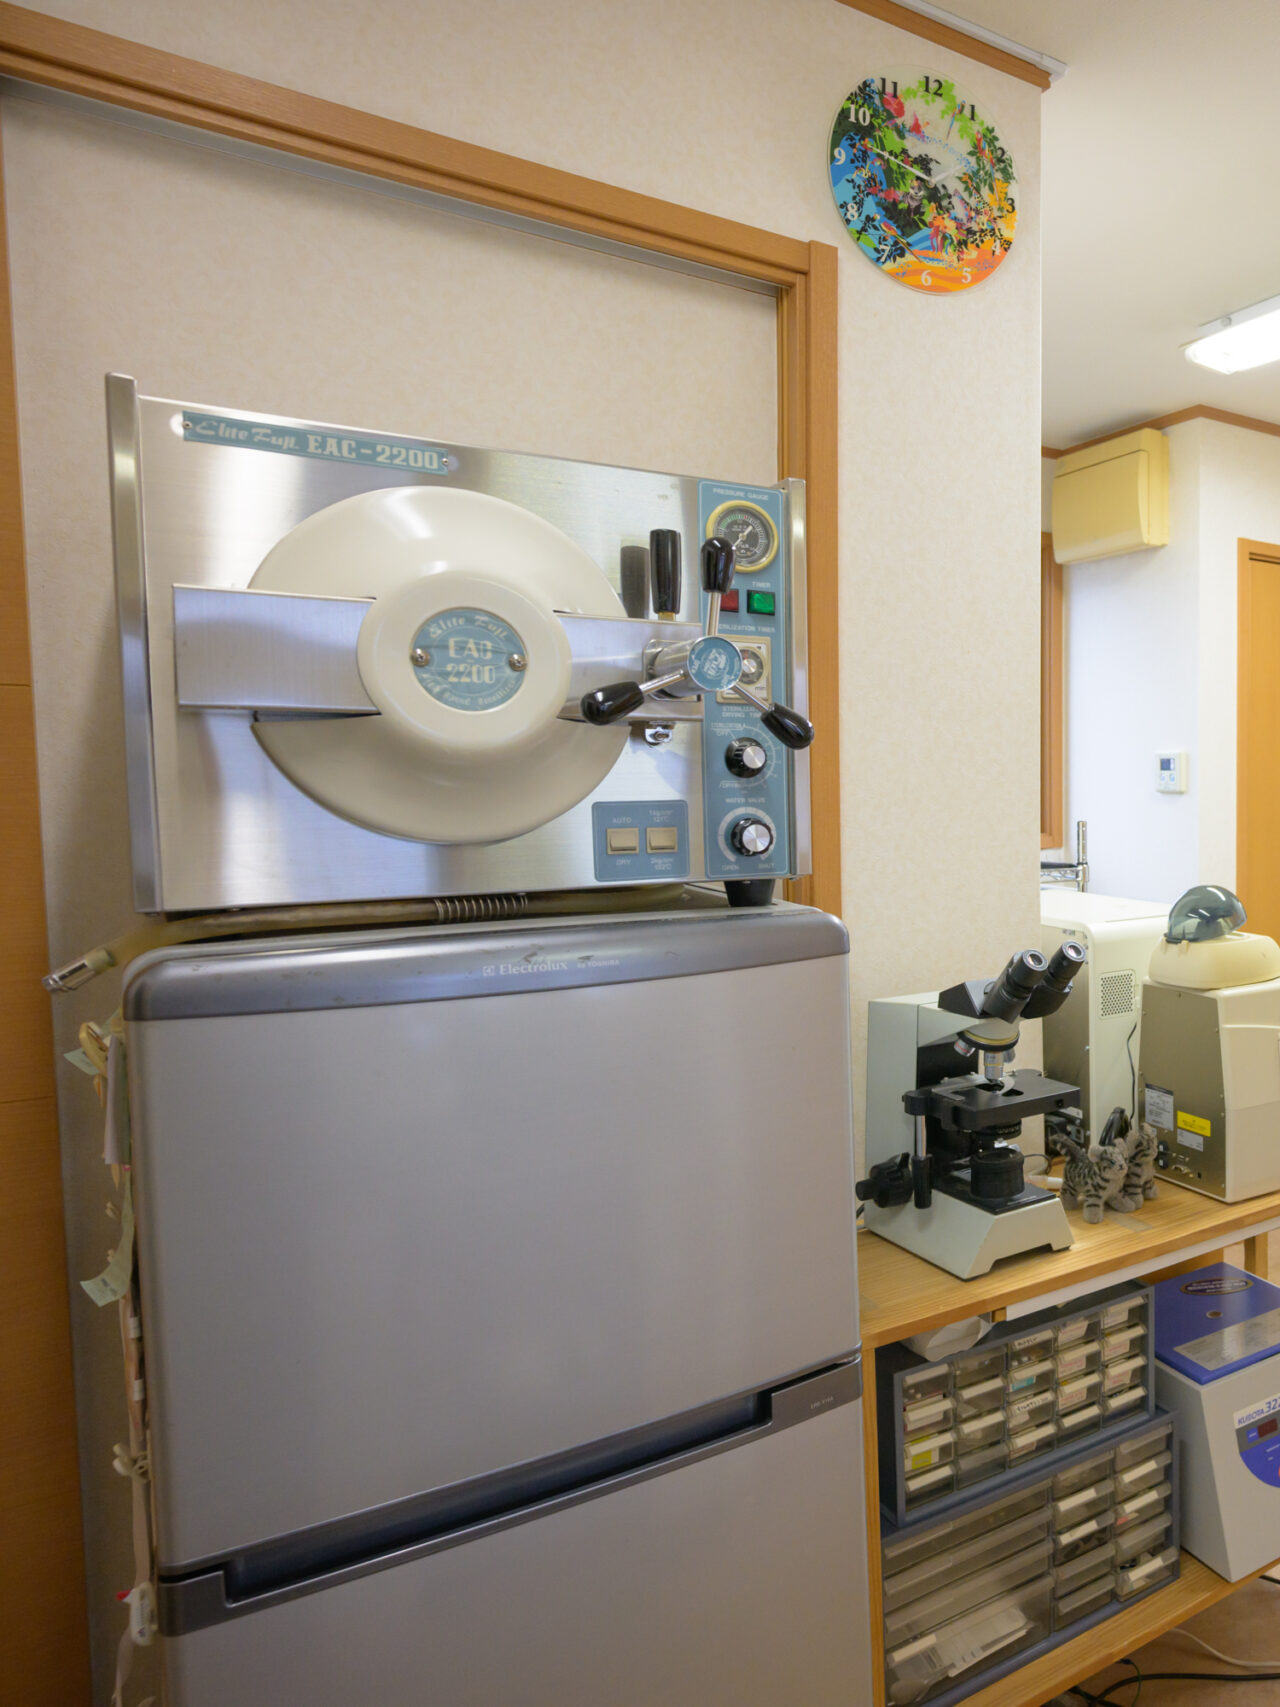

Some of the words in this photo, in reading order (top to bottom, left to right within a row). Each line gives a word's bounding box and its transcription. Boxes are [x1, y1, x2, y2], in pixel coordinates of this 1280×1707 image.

[880, 77, 898, 98] 11
[923, 76, 943, 97] 12
[848, 104, 870, 126] 10
[969, 104, 976, 121] 1
[834, 147, 846, 165] 9
[846, 202, 858, 221] 8
[1006, 198, 1015, 213] 3
[879, 245, 891, 261] 7
[920, 270, 932, 286] 6
[961, 268, 972, 284] 5
[306, 434, 439, 470] EAC-2200
[448, 637, 493, 660] EAC
[445, 663, 496, 684] 2200
[500, 961, 568, 976] Electrolux
[588, 960, 620, 968] TOSHIBA
[1238, 1408, 1265, 1425] KUBOTA
